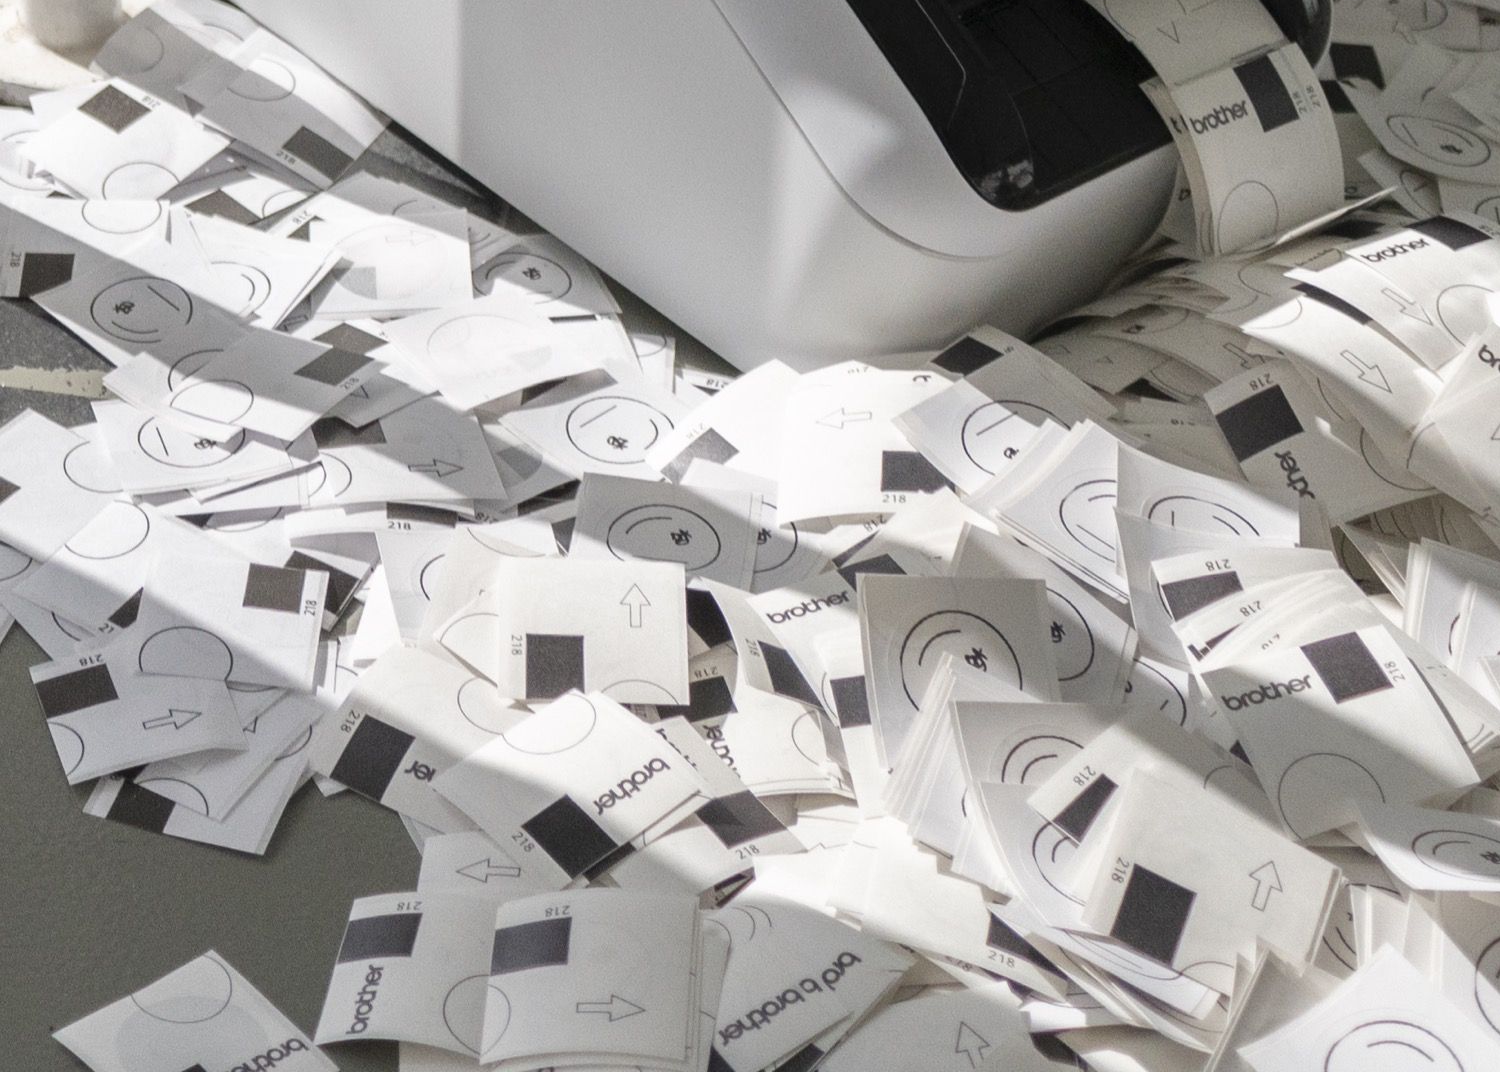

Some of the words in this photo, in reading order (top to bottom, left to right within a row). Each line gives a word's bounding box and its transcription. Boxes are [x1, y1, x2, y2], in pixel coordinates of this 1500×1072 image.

[1190, 100, 1251, 135] brother
[276, 149, 298, 166] 218
[9, 251, 22, 269] 218
[1361, 237, 1430, 263] brother
[1249, 373, 1273, 392] 218
[882, 493, 907, 504] 218
[387, 520, 412, 531] 218
[1205, 558, 1232, 572] 218
[303, 599, 317, 617] 218
[766, 589, 850, 625] brother
[1239, 600, 1263, 618] 218
[511, 634, 523, 656] 218
[78, 653, 103, 668] 218
[1384, 661, 1405, 683] 218
[1221, 675, 1312, 711] brother
[340, 709, 361, 734] 218
[1073, 765, 1097, 786] 218
[593, 757, 672, 816] brother
[511, 831, 535, 854] 218
[735, 844, 760, 861] 218
[1112, 856, 1130, 884] 218
[397, 900, 423, 912] 218
[545, 904, 571, 918] 218
[987, 950, 1016, 969] 218
[345, 964, 385, 1035] brother
[718, 988, 806, 1046] brother
